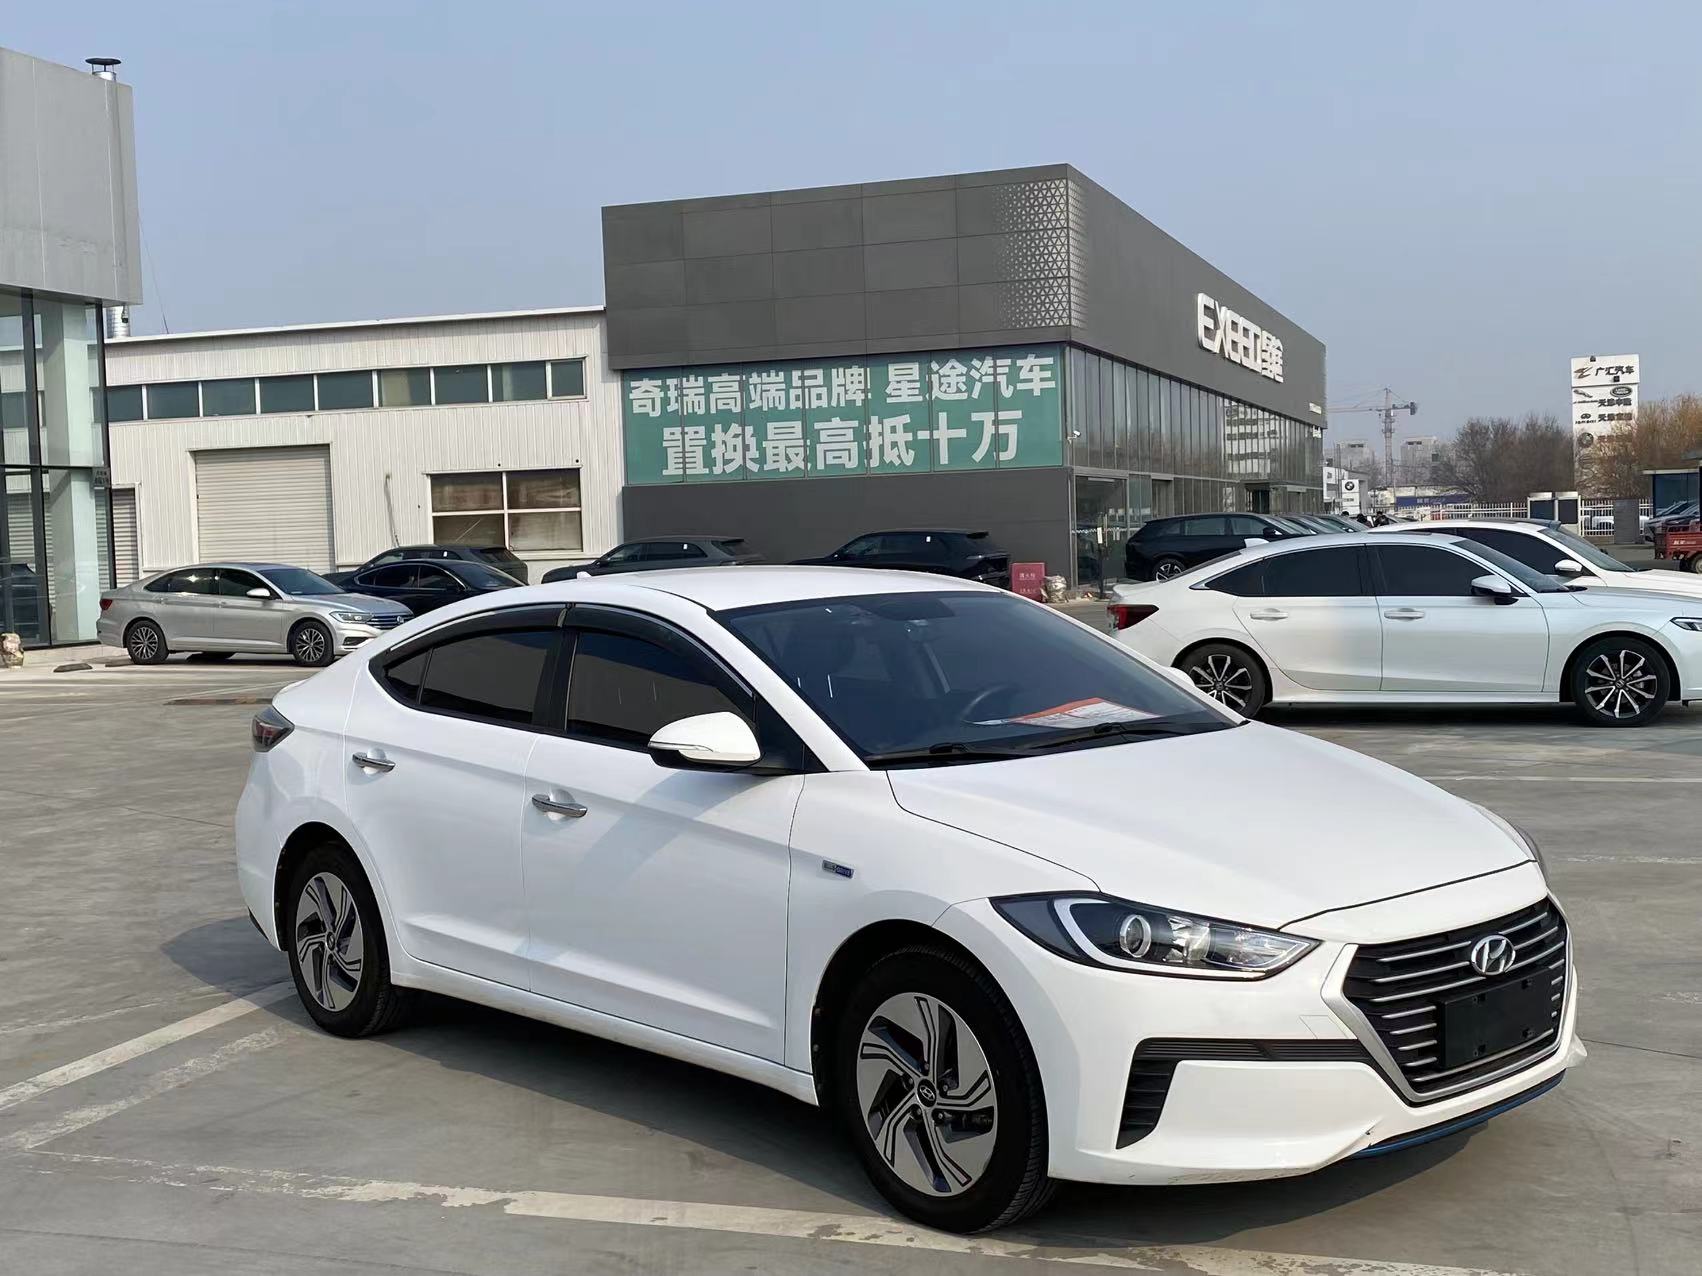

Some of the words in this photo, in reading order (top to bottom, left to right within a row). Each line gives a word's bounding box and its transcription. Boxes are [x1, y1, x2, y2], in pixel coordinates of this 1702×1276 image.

[1198, 293, 1261, 373] EXEED
[629, 365, 871, 417] 奇瑞高端品牌
[885, 354, 1057, 403] 星途汽车
[1595, 365, 1635, 376] 广汇汽车
[662, 410, 1024, 476] 置换最高抵十万
